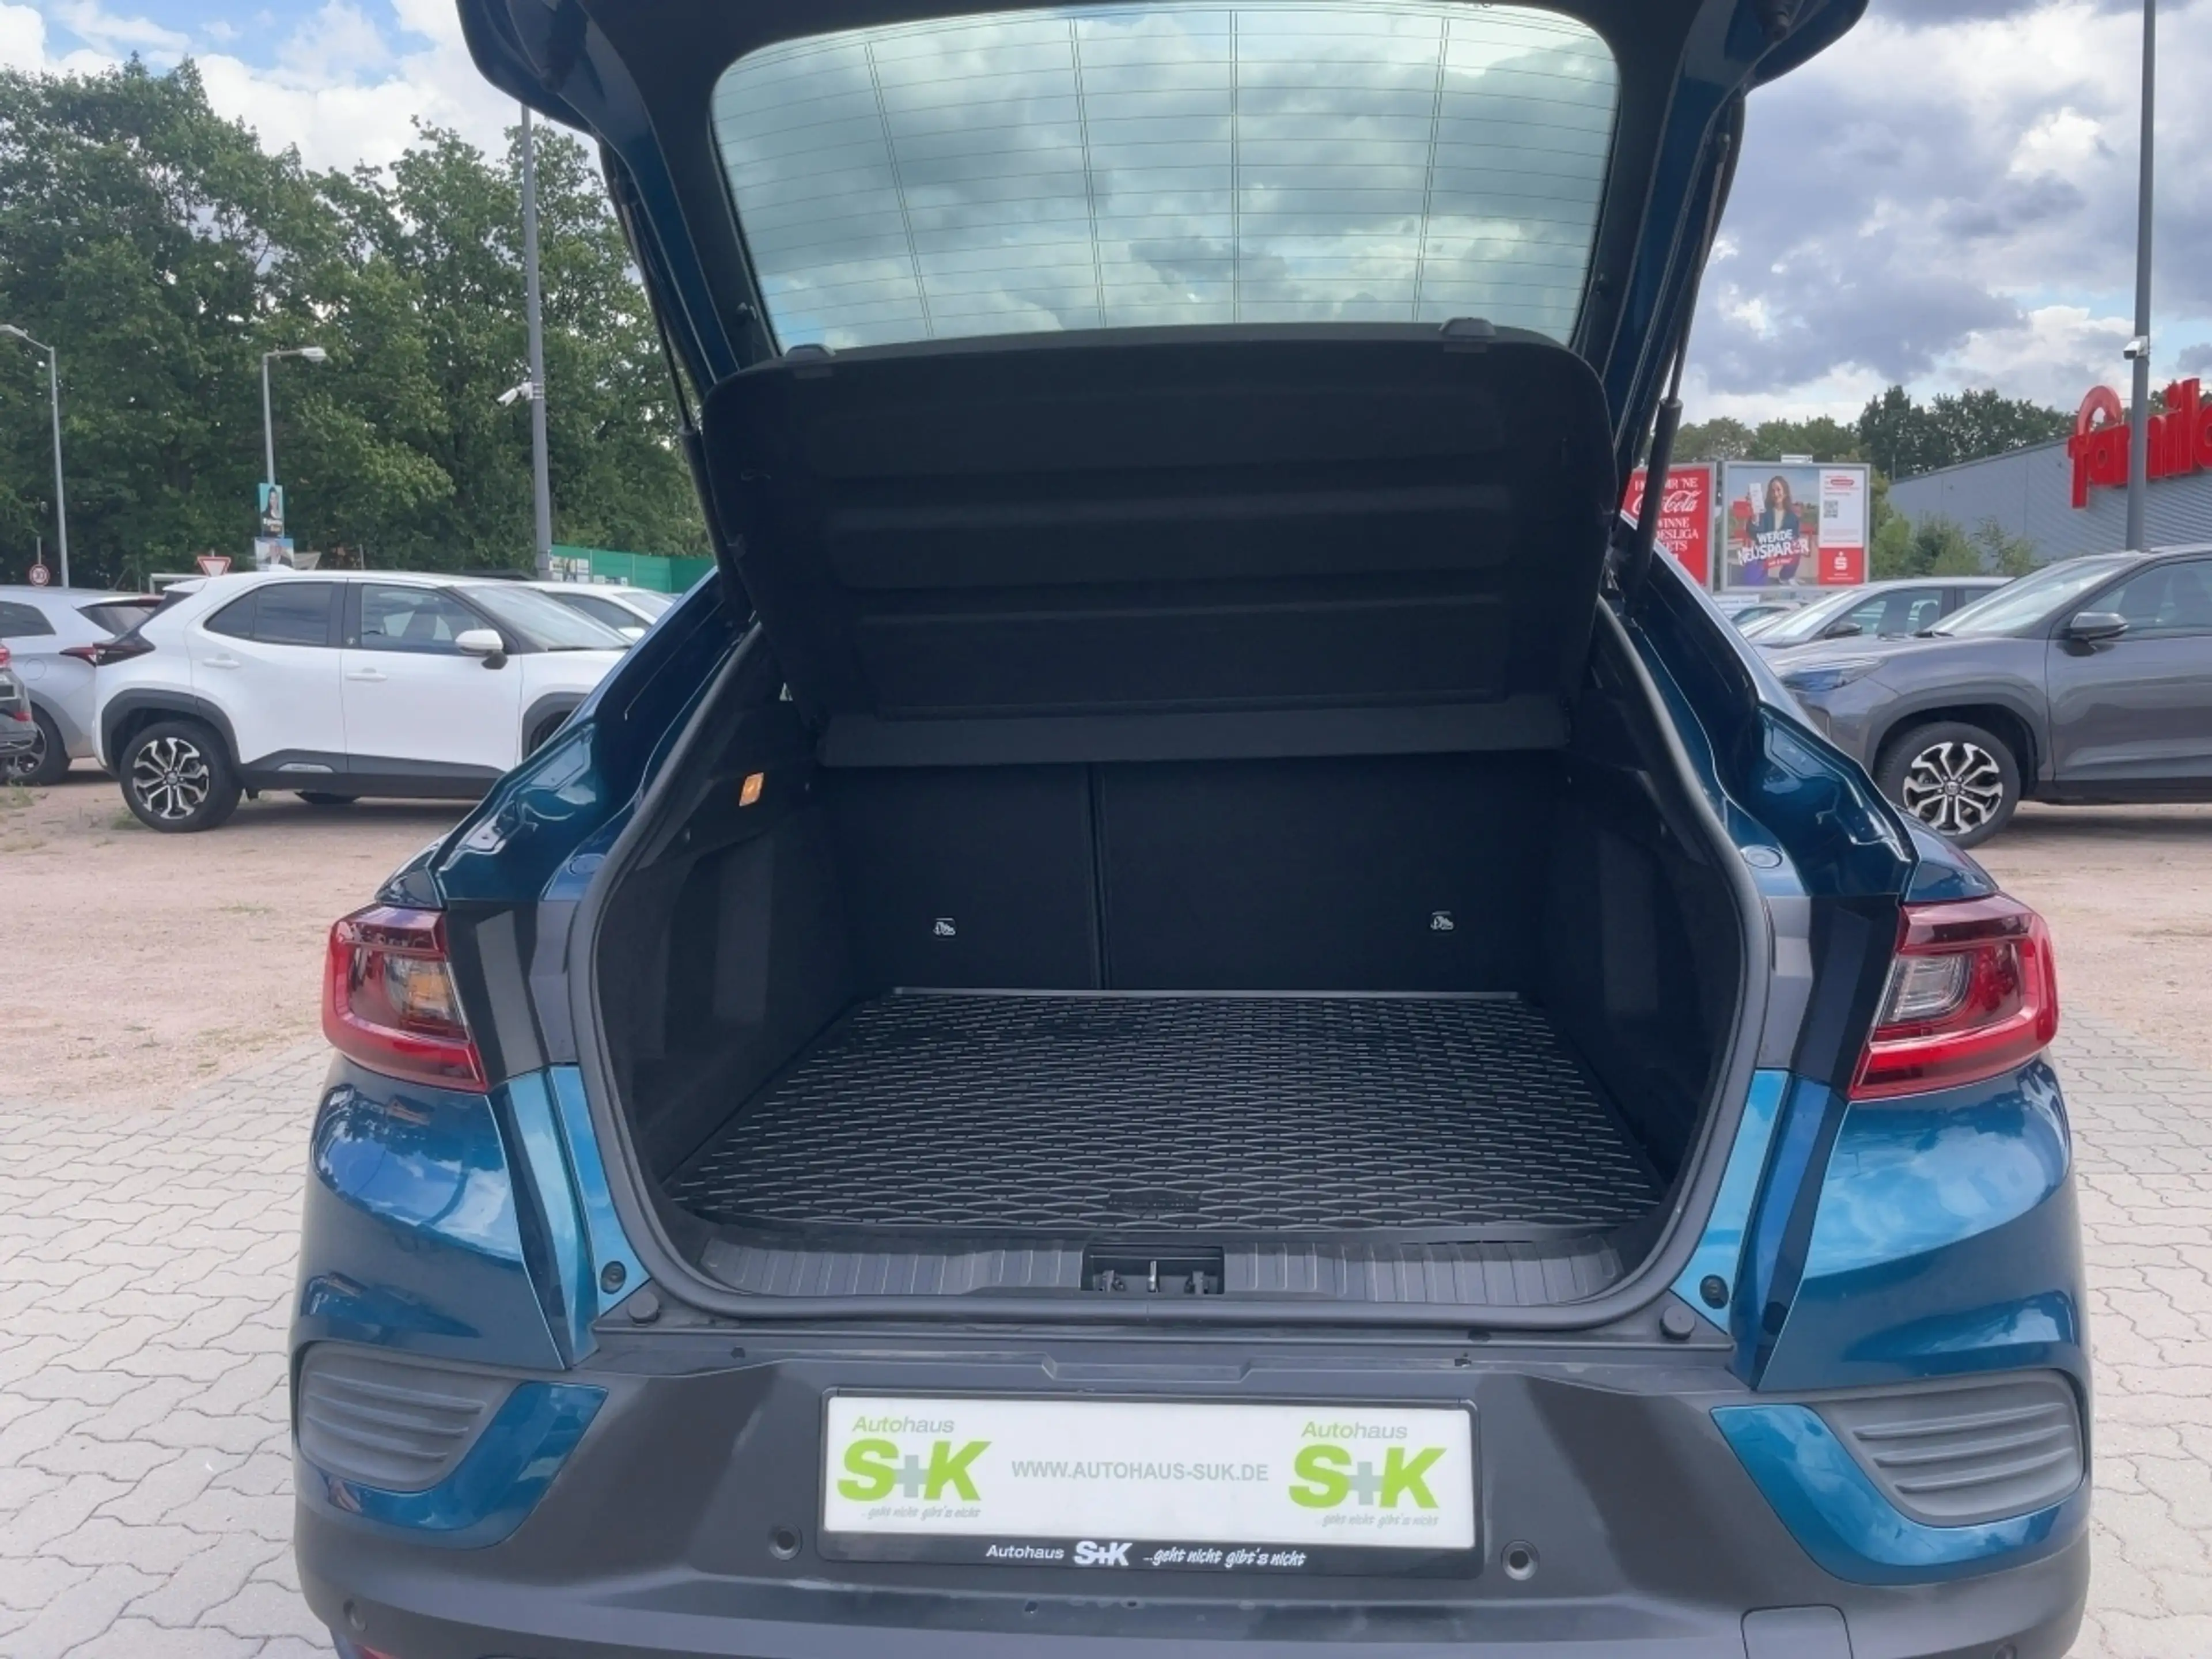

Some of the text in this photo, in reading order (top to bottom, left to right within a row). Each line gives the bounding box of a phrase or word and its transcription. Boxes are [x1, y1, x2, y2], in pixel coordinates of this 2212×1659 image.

[1756, 529, 1793, 544] WERDE
[853, 1416, 955, 1433] Autohaus
[1301, 1421, 1408, 1440] Autohaus
[837, 1438, 993, 1502] S+K
[1012, 1460, 1268, 1482] WWW.AUTOHAUS-SUK.DE
[1289, 1444, 1448, 1509] S+K
[893, 1506, 919, 1518] nicht
[986, 1544, 1065, 1559] Autohaus
[1073, 1540, 1132, 1566] S+K
[1187, 1548, 1222, 1564] nicht
[1225, 1547, 1268, 1568] gibt's
[1270, 1550, 1306, 1566] nicht
